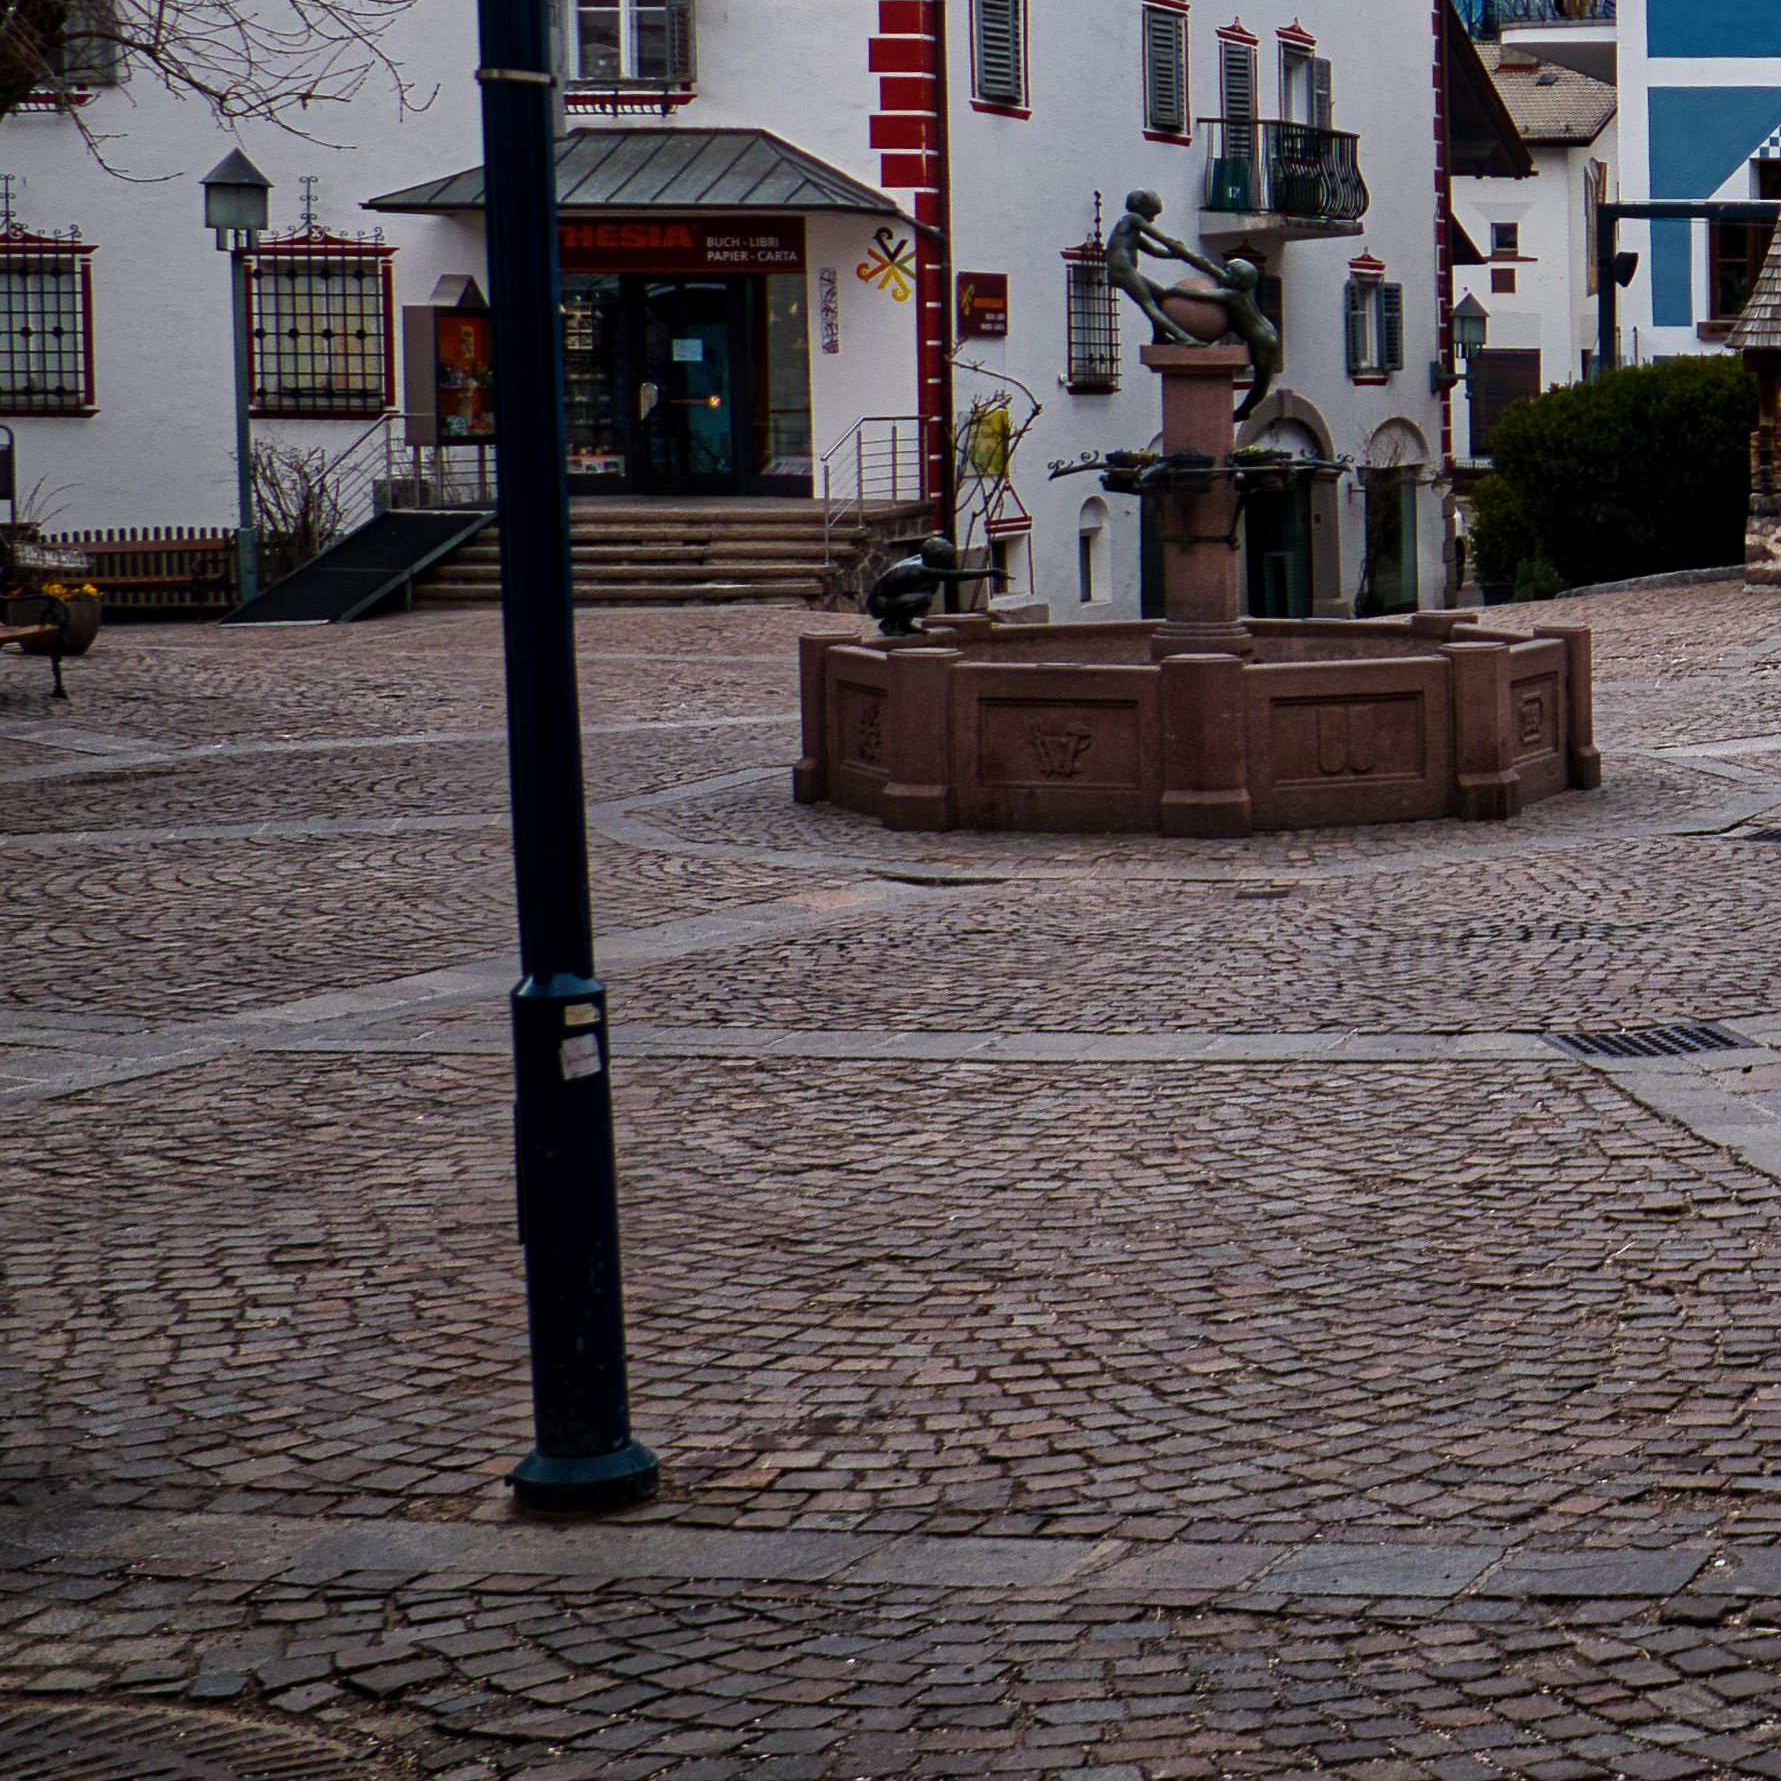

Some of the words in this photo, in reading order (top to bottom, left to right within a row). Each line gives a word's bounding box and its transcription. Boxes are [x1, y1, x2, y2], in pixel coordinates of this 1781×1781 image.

[706, 236, 740, 248] BUCH
[749, 236, 779, 248] LIBRI
[706, 250, 749, 262] PAPIER
[757, 250, 799, 262] CARTA
